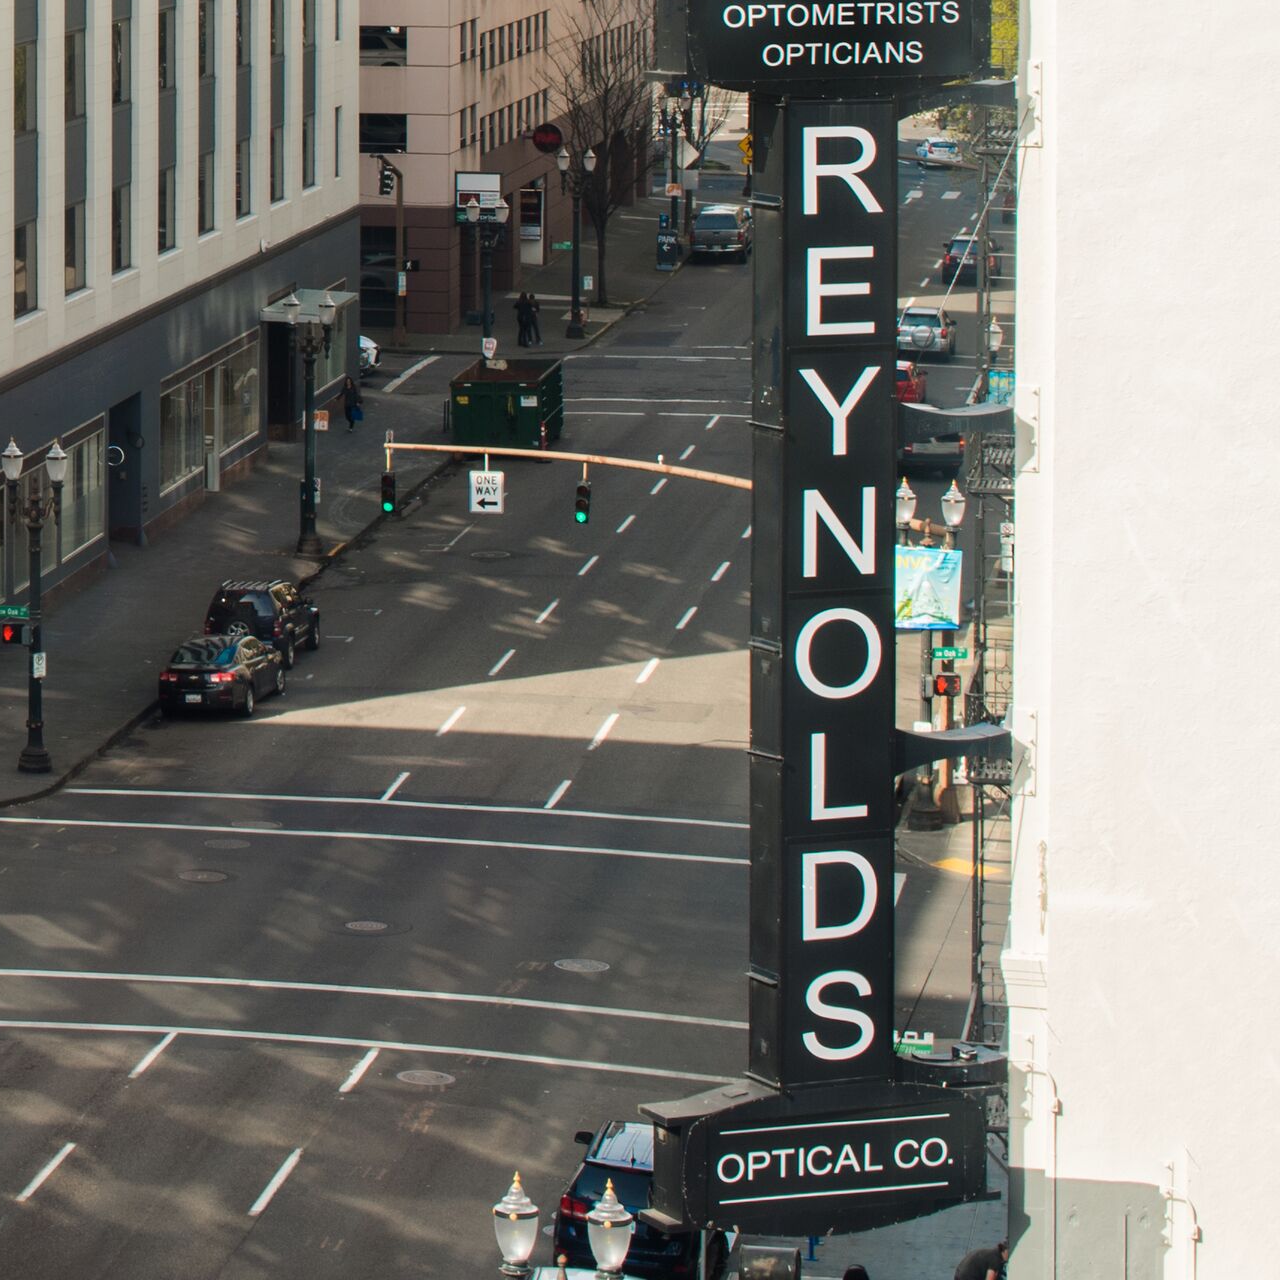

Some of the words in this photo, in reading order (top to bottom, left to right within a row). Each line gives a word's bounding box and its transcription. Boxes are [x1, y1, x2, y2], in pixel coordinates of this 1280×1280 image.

[723, 0, 960, 29] OPTOMETRISTS
[762, 40, 924, 67] OPTICIANS
[658, 235, 676, 244] PARK
[476, 475, 497, 485] ONE
[475, 486, 498, 495] WAY
[795, 125, 884, 1061] REYNOLDS
[7, 608, 19, 616] Oak
[944, 649, 956, 657] Oak
[717, 1142, 883, 1183] OPTICAL
[893, 1137, 954, 1169] CO.
